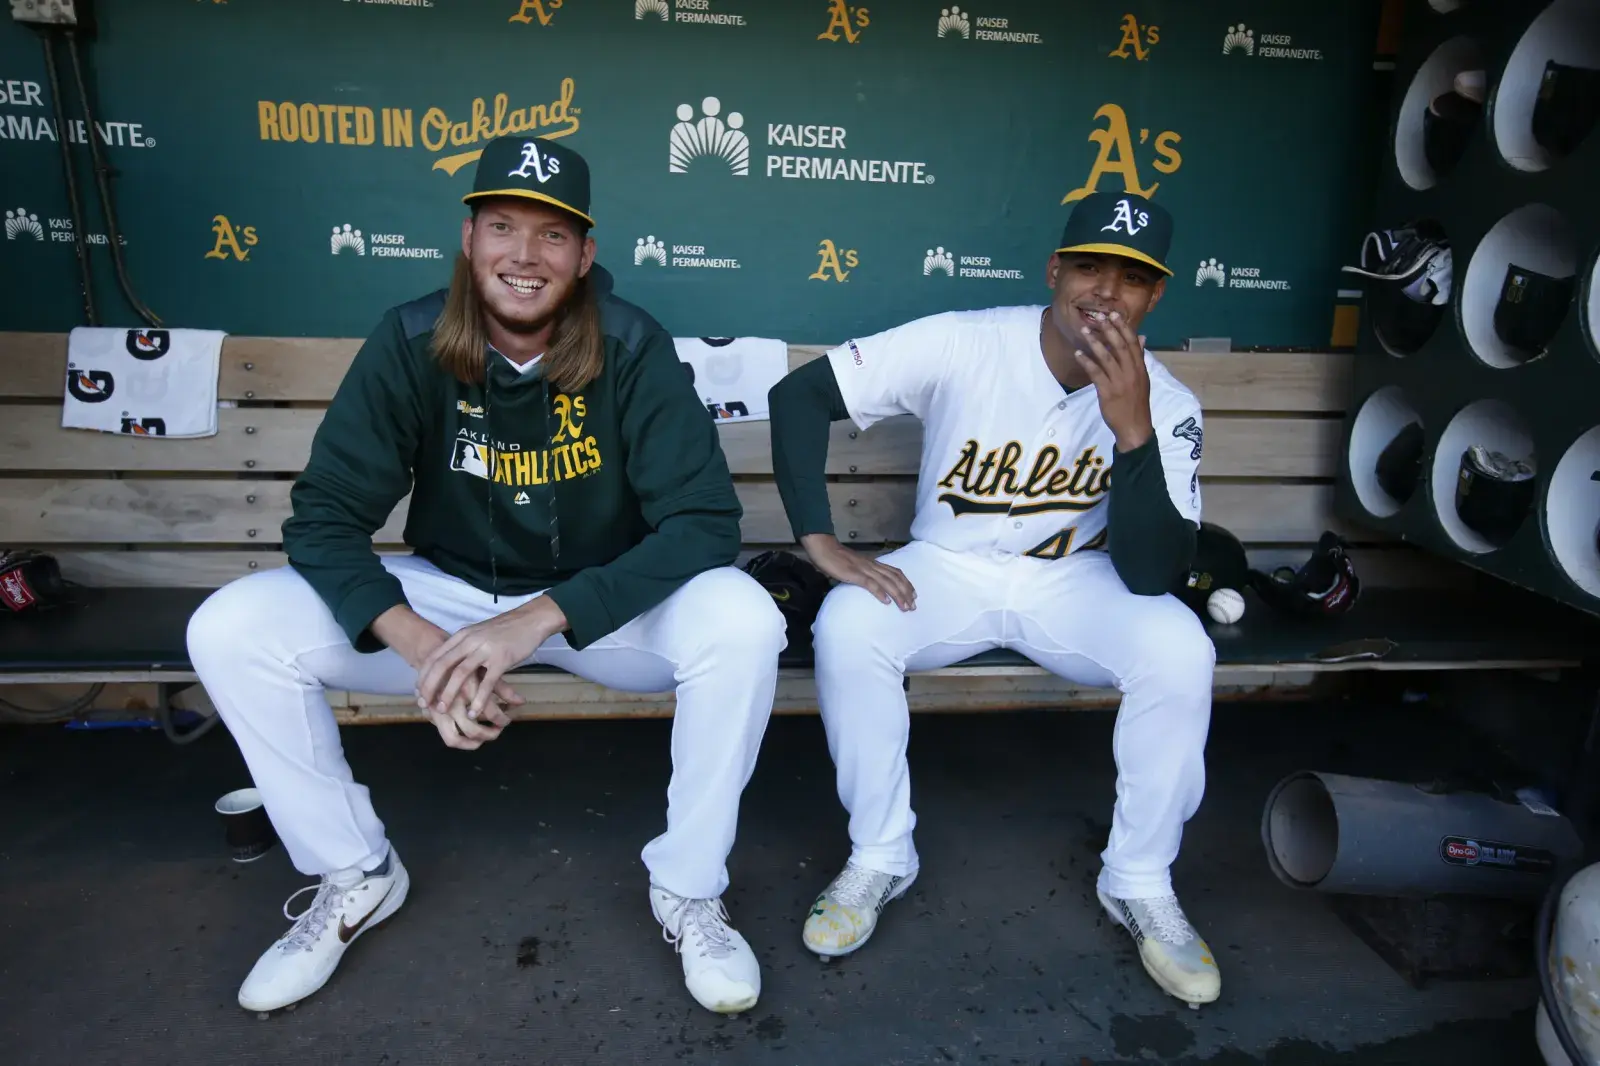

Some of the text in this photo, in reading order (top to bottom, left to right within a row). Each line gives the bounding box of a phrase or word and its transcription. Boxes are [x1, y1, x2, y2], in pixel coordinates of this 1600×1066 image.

[675, 0, 709, 10] KAISER
[675, 12, 743, 26] PERMANENTE
[817, 0, 870, 44] A's
[976, 17, 1008, 29] KAISER
[975, 30, 1041, 44] PERMANENTE
[1108, 13, 1160, 61] A's
[1260, 34, 1291, 45] KAISER
[1259, 47, 1320, 60] PERMANENTE
[0, 80, 44, 107] SER
[258, 100, 376, 146] ROOTED
[382, 108, 413, 148] IN
[420, 77, 580, 152] Oakland
[768, 123, 846, 149] KAISER
[1060, 103, 1183, 206] A's
[508, 142, 561, 184] A's
[767, 155, 926, 185] PERMANENTE
[1100, 199, 1149, 236] A's
[204, 214, 259, 262] A's
[371, 233, 405, 245] KAISER
[371, 247, 439, 259] PERMANENTE
[672, 244, 705, 256] KAISER
[672, 257, 738, 269] PERMANENTE
[808, 239, 859, 283] A's
[960, 256, 991, 267] KAISER
[959, 267, 1021, 280] PERMANENTE
[1230, 267, 1260, 278] KAISER
[1229, 279, 1288, 290] PERMANENTE
[458, 427, 521, 451] AKLND
[937, 438, 1112, 498] Athletic
